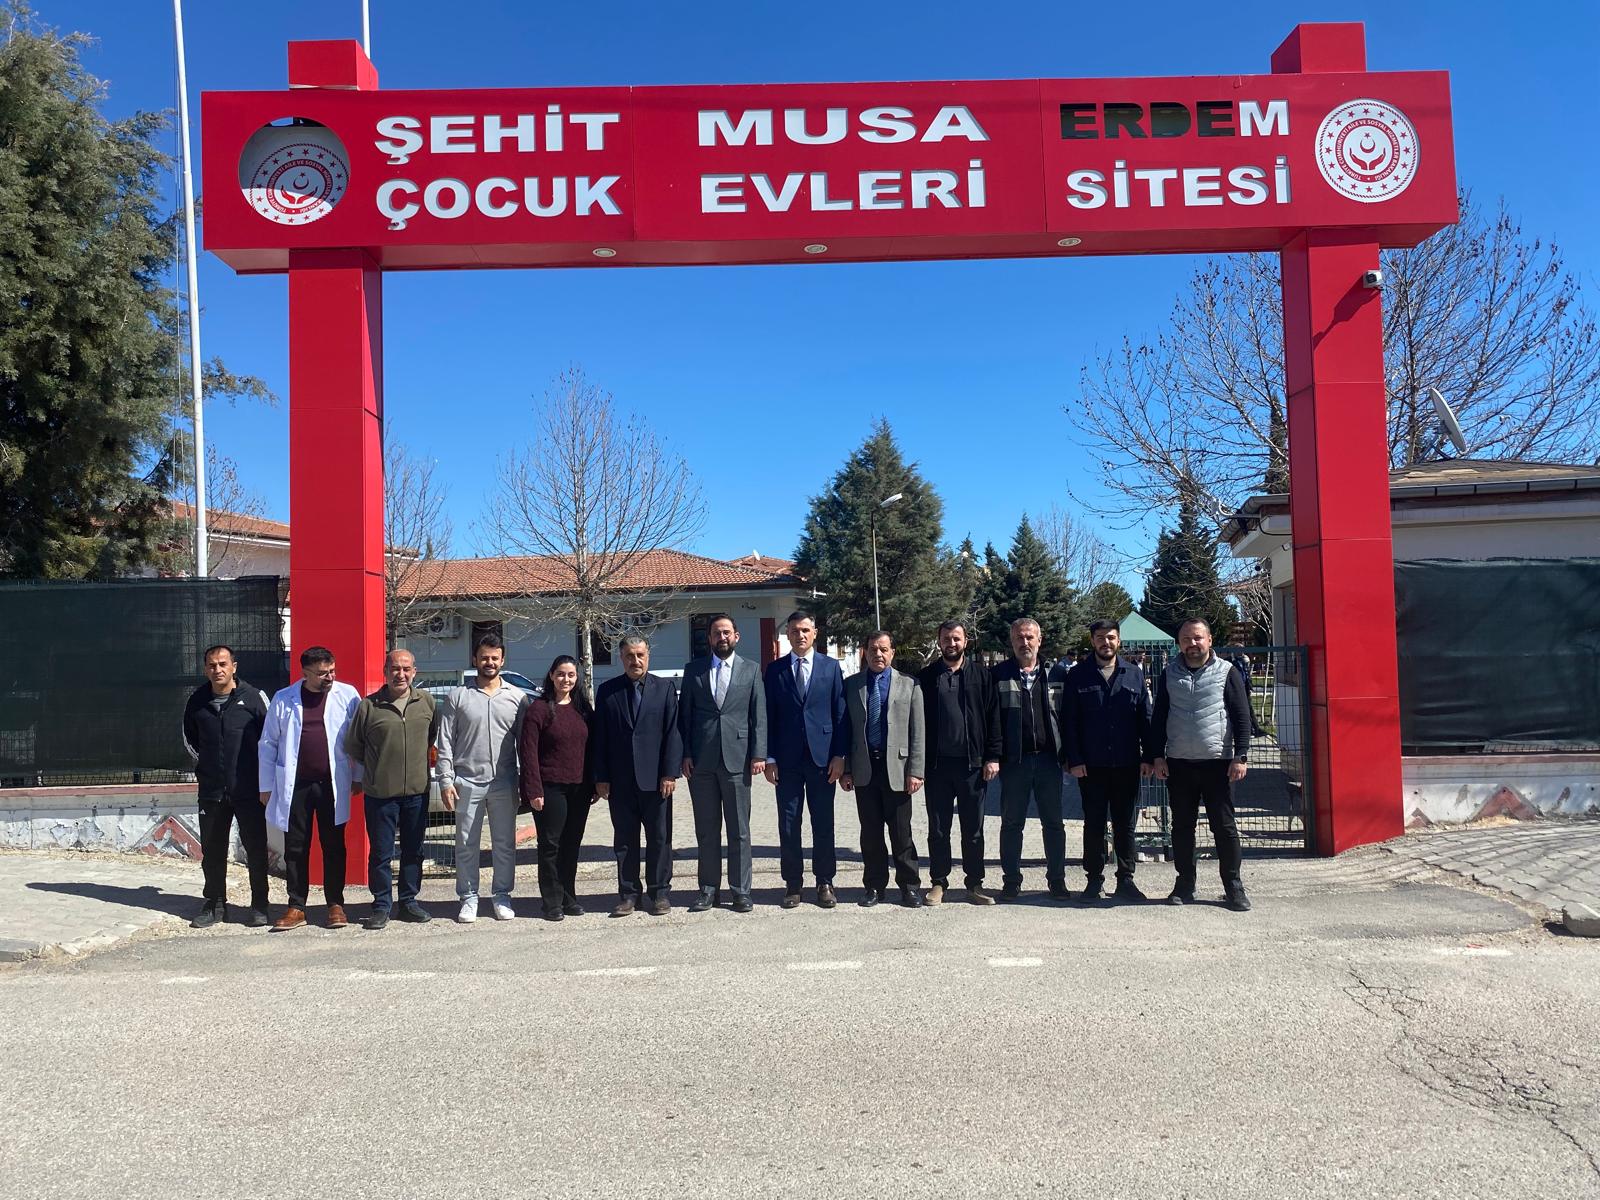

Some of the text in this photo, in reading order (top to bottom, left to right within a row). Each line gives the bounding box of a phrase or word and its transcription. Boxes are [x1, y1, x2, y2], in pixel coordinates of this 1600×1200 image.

[375, 100, 1290, 164] ŞEHİT MUSA ERDEM
[376, 156, 1291, 229] ÇOCUK EVLERİ SİTESİ
